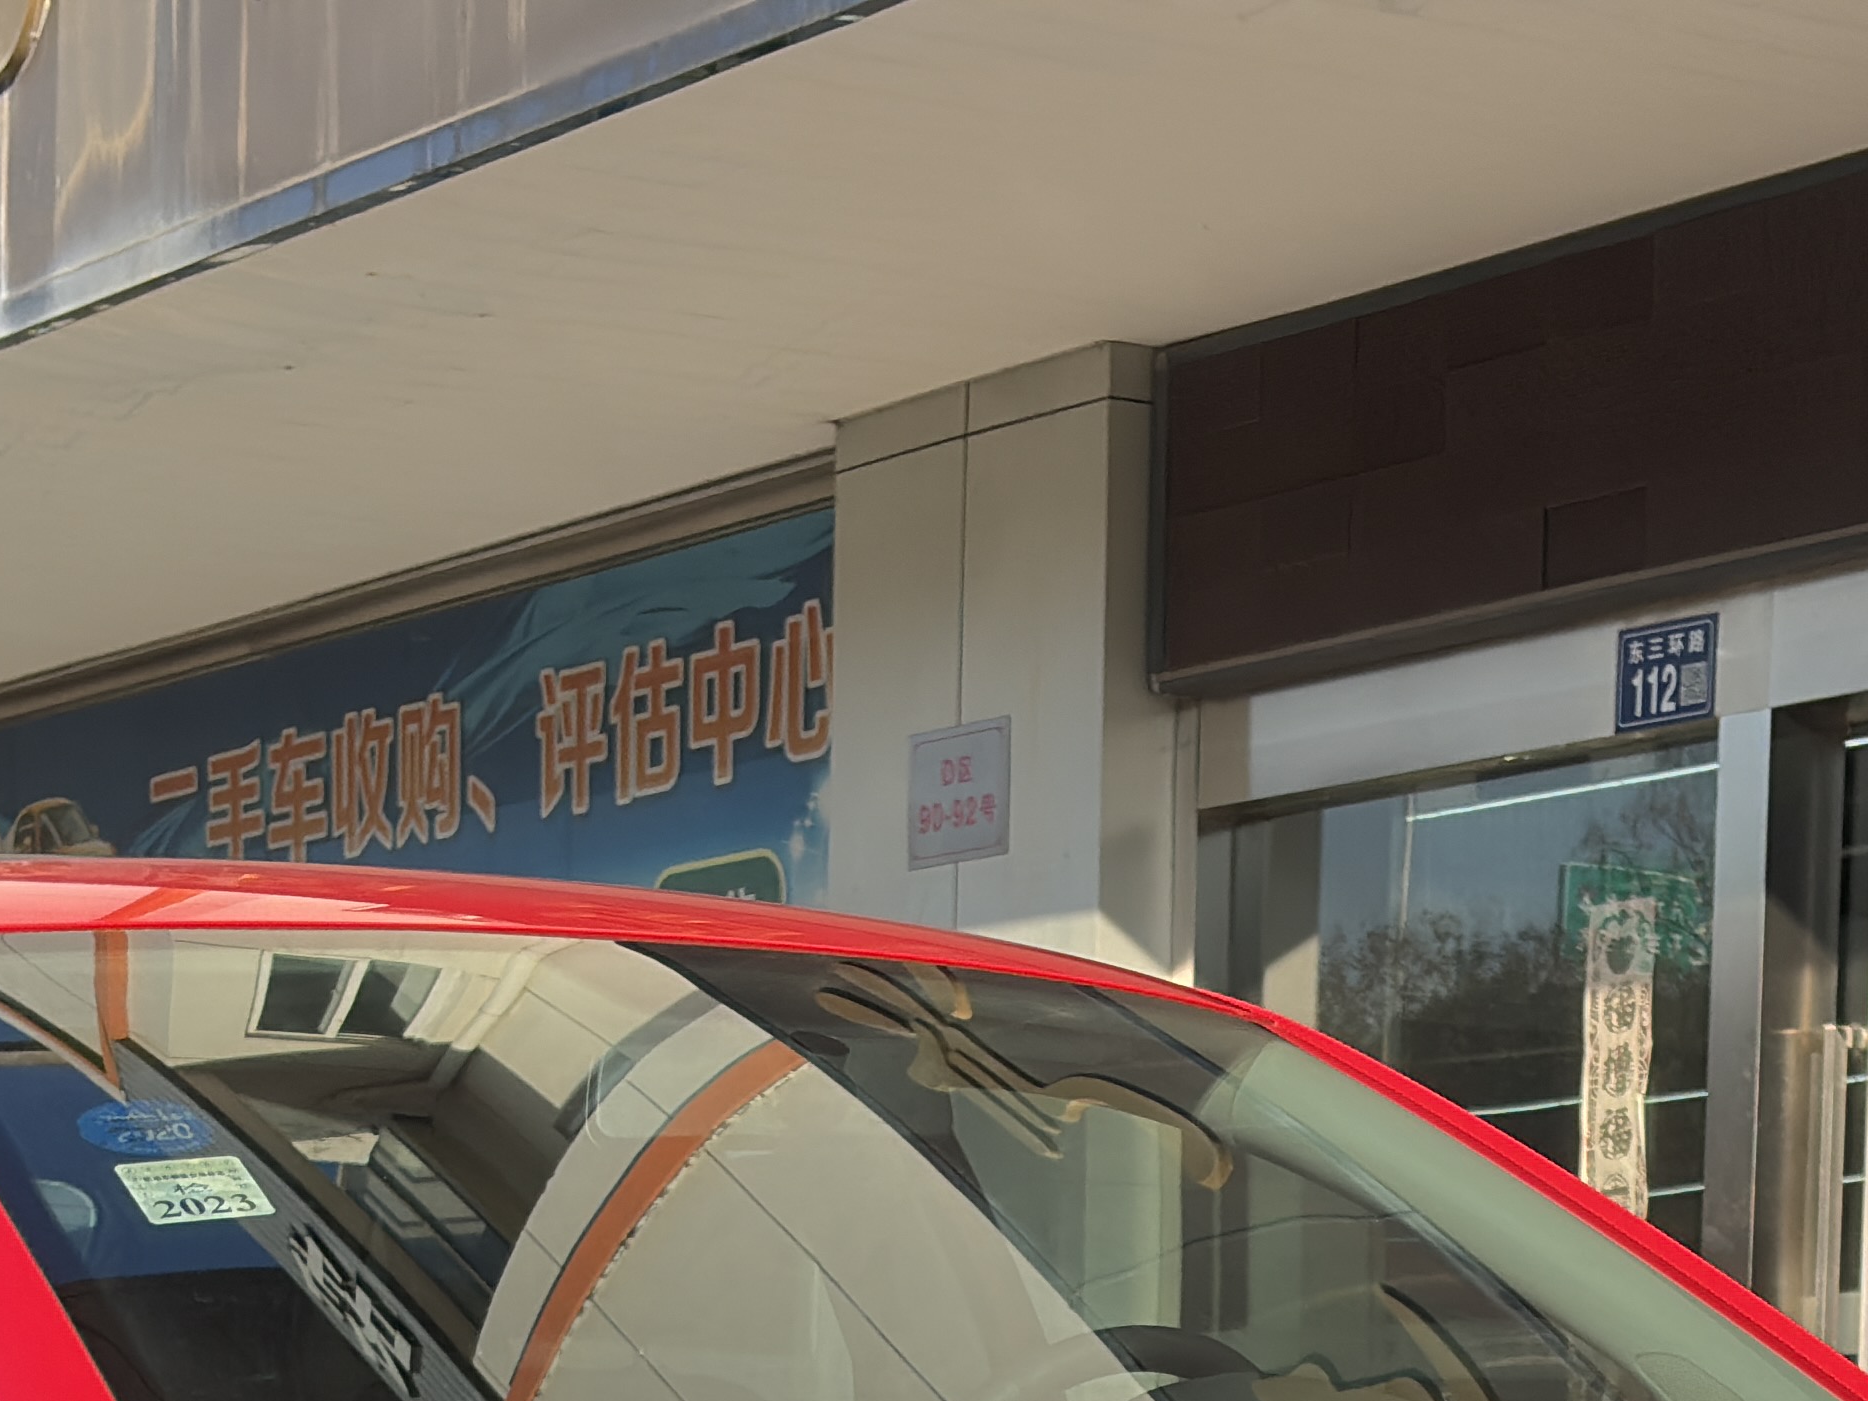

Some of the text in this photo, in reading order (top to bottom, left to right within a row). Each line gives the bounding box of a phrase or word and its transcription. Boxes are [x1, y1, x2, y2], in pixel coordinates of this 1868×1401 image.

[1627, 629, 1705, 664] 东三环路
[1631, 664, 1677, 717] 112
[152, 1193, 257, 1219] 2023
